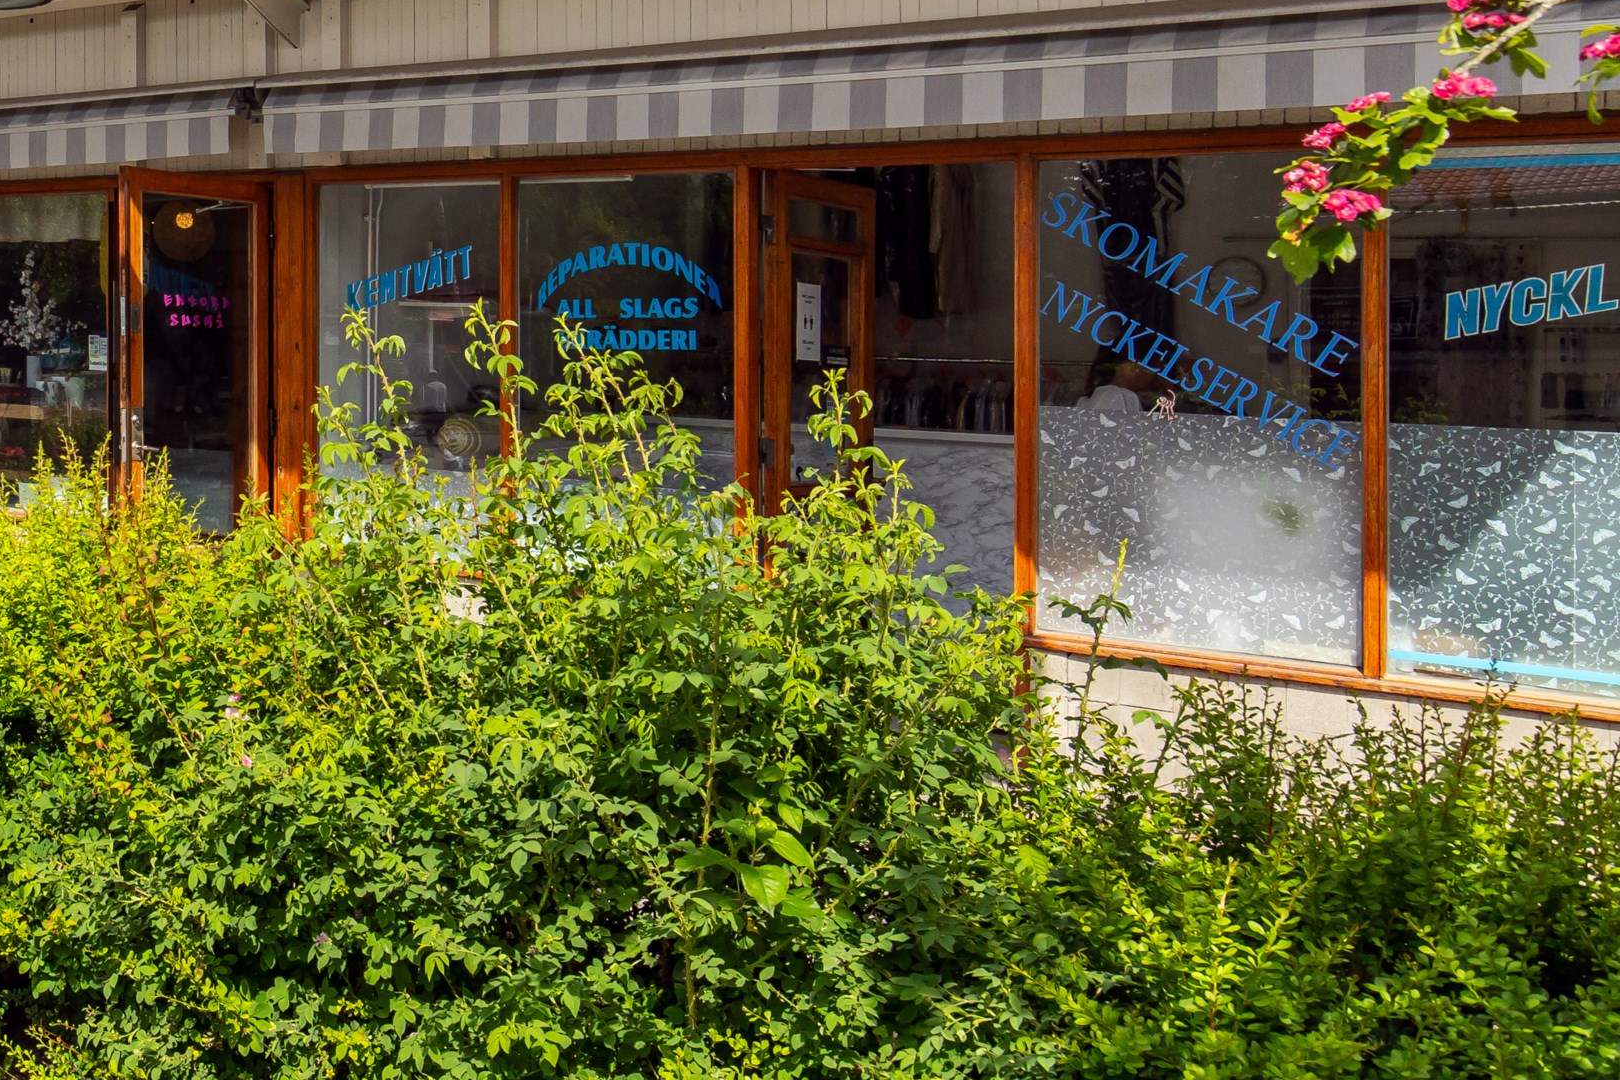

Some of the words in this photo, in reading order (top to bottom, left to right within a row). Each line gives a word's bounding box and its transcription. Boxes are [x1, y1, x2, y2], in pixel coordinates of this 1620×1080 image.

[347, 245, 473, 311] KEMTVÄTT
[537, 242, 723, 312] REPARATIONER
[557, 298, 597, 319] ALL
[619, 297, 699, 319] SLAGS
[1041, 191, 1359, 378] SKOMAKARE
[1444, 263, 1619, 341] NYCKL
[1039, 281, 1359, 470] NYCKELSERVICE
